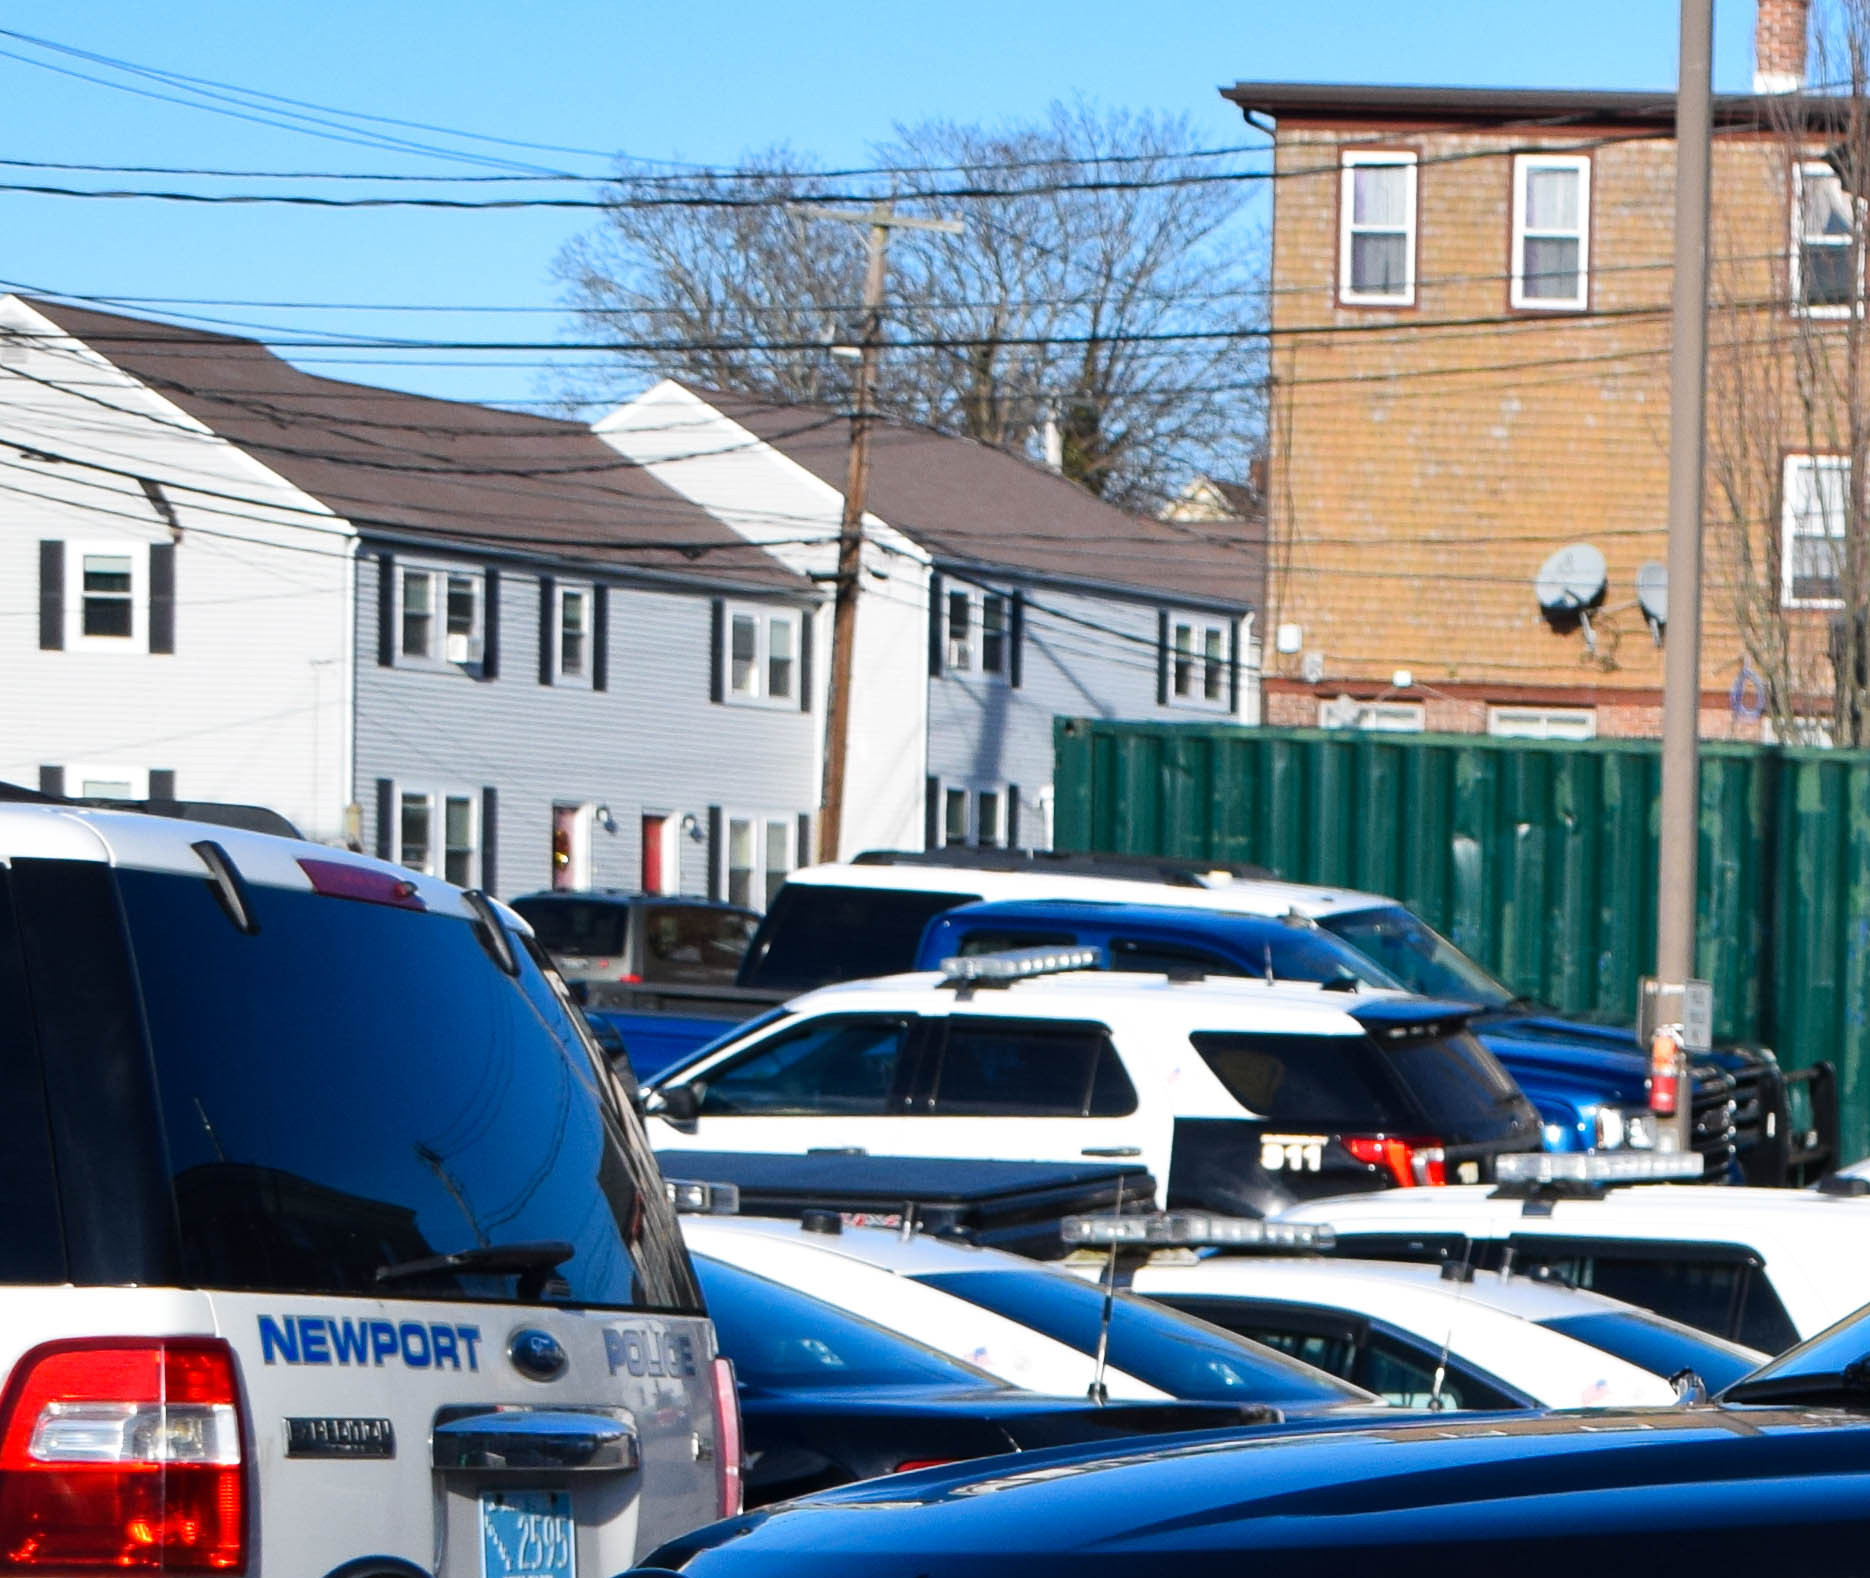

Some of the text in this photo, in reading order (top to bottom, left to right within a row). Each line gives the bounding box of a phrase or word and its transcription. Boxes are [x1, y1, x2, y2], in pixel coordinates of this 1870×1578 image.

[257, 1314, 697, 1377] NEWPORT POLICE
[517, 1514, 569, 1571] 2595
